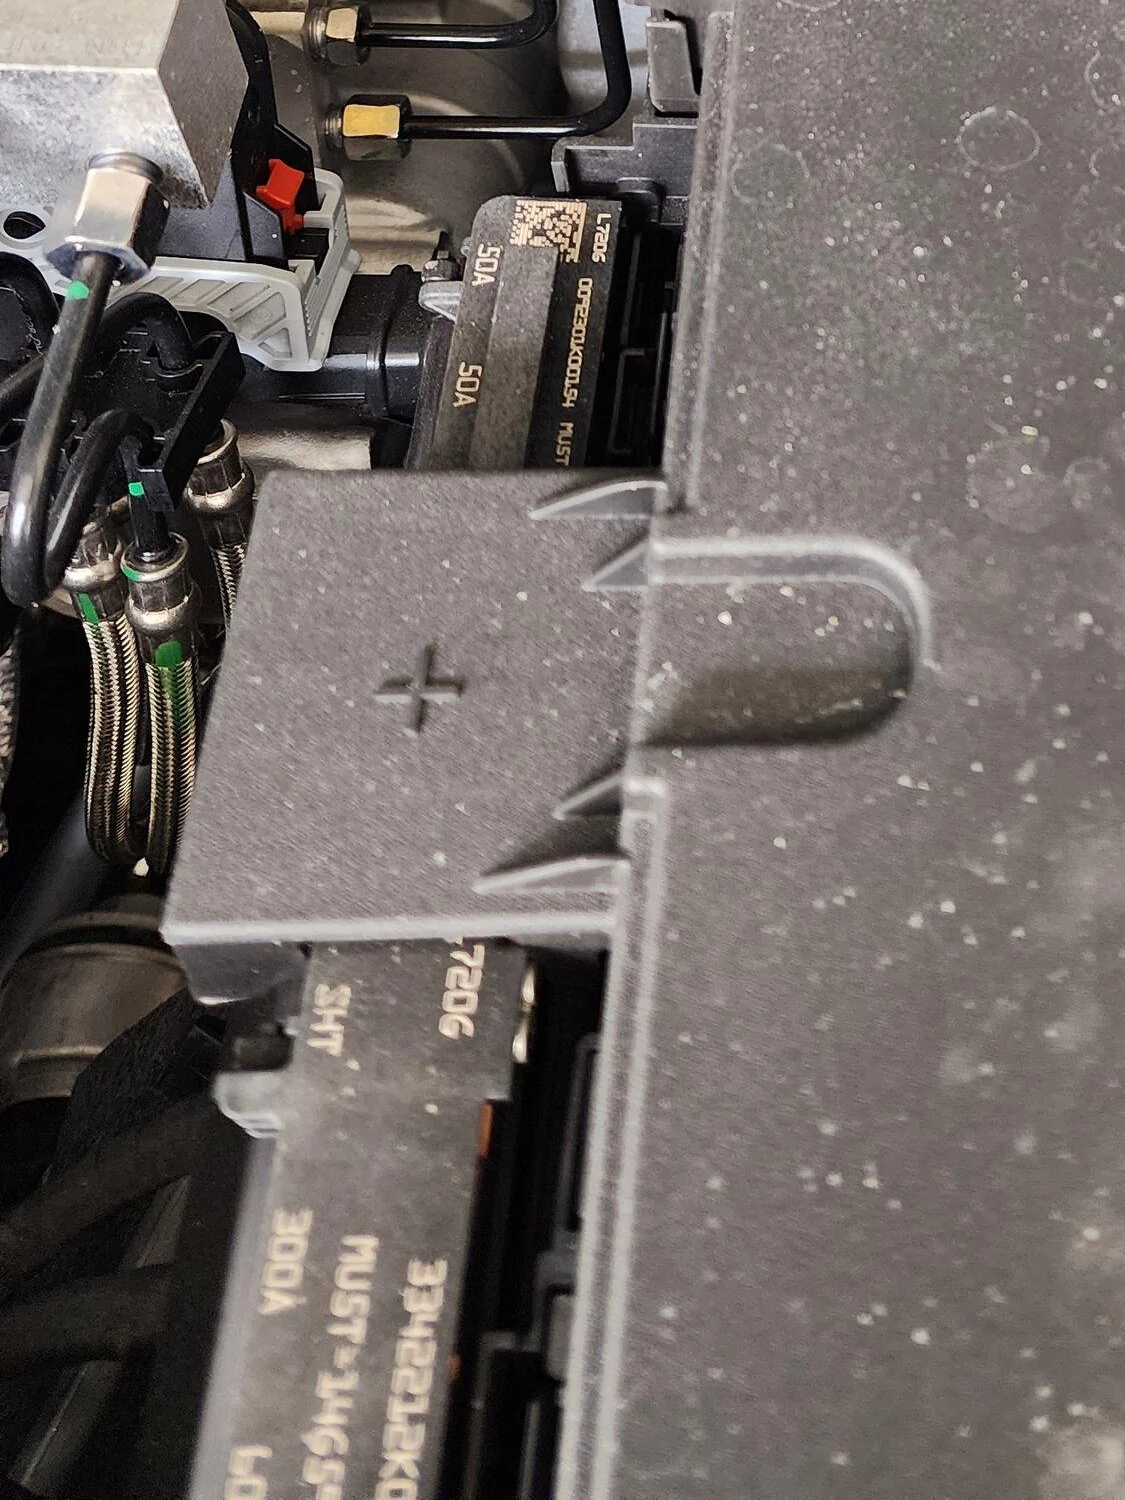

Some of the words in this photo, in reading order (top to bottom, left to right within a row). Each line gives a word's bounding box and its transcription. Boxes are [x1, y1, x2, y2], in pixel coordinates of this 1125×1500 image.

[591, 212, 612, 264] L7206
[471, 243, 502, 287] 50A
[453, 361, 483, 408] 50A
[554, 421, 574, 467] MUST
[438, 936, 486, 1040] 7206
[259, 1207, 313, 1317] 300A
